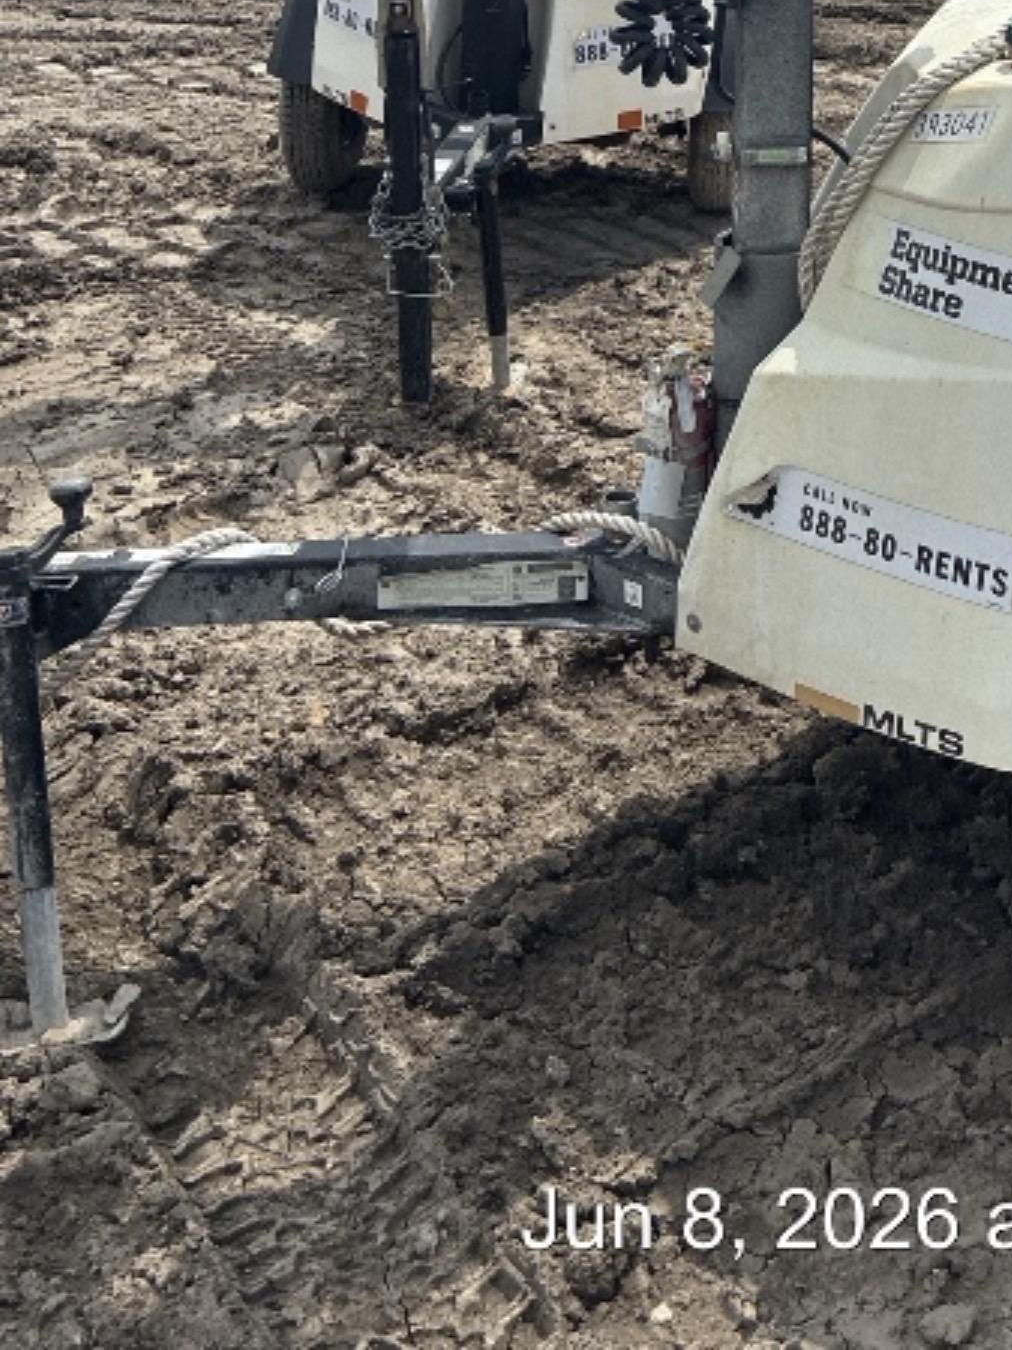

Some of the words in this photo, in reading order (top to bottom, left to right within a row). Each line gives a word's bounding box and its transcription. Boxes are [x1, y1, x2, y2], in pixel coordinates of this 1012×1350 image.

[878, 264, 963, 318] Share
[803, 482, 835, 505] CALL
[842, 497, 874, 518] NOW
[799, 503, 1010, 598] 888-80-RENTS
[863, 704, 964, 756] MLTS
